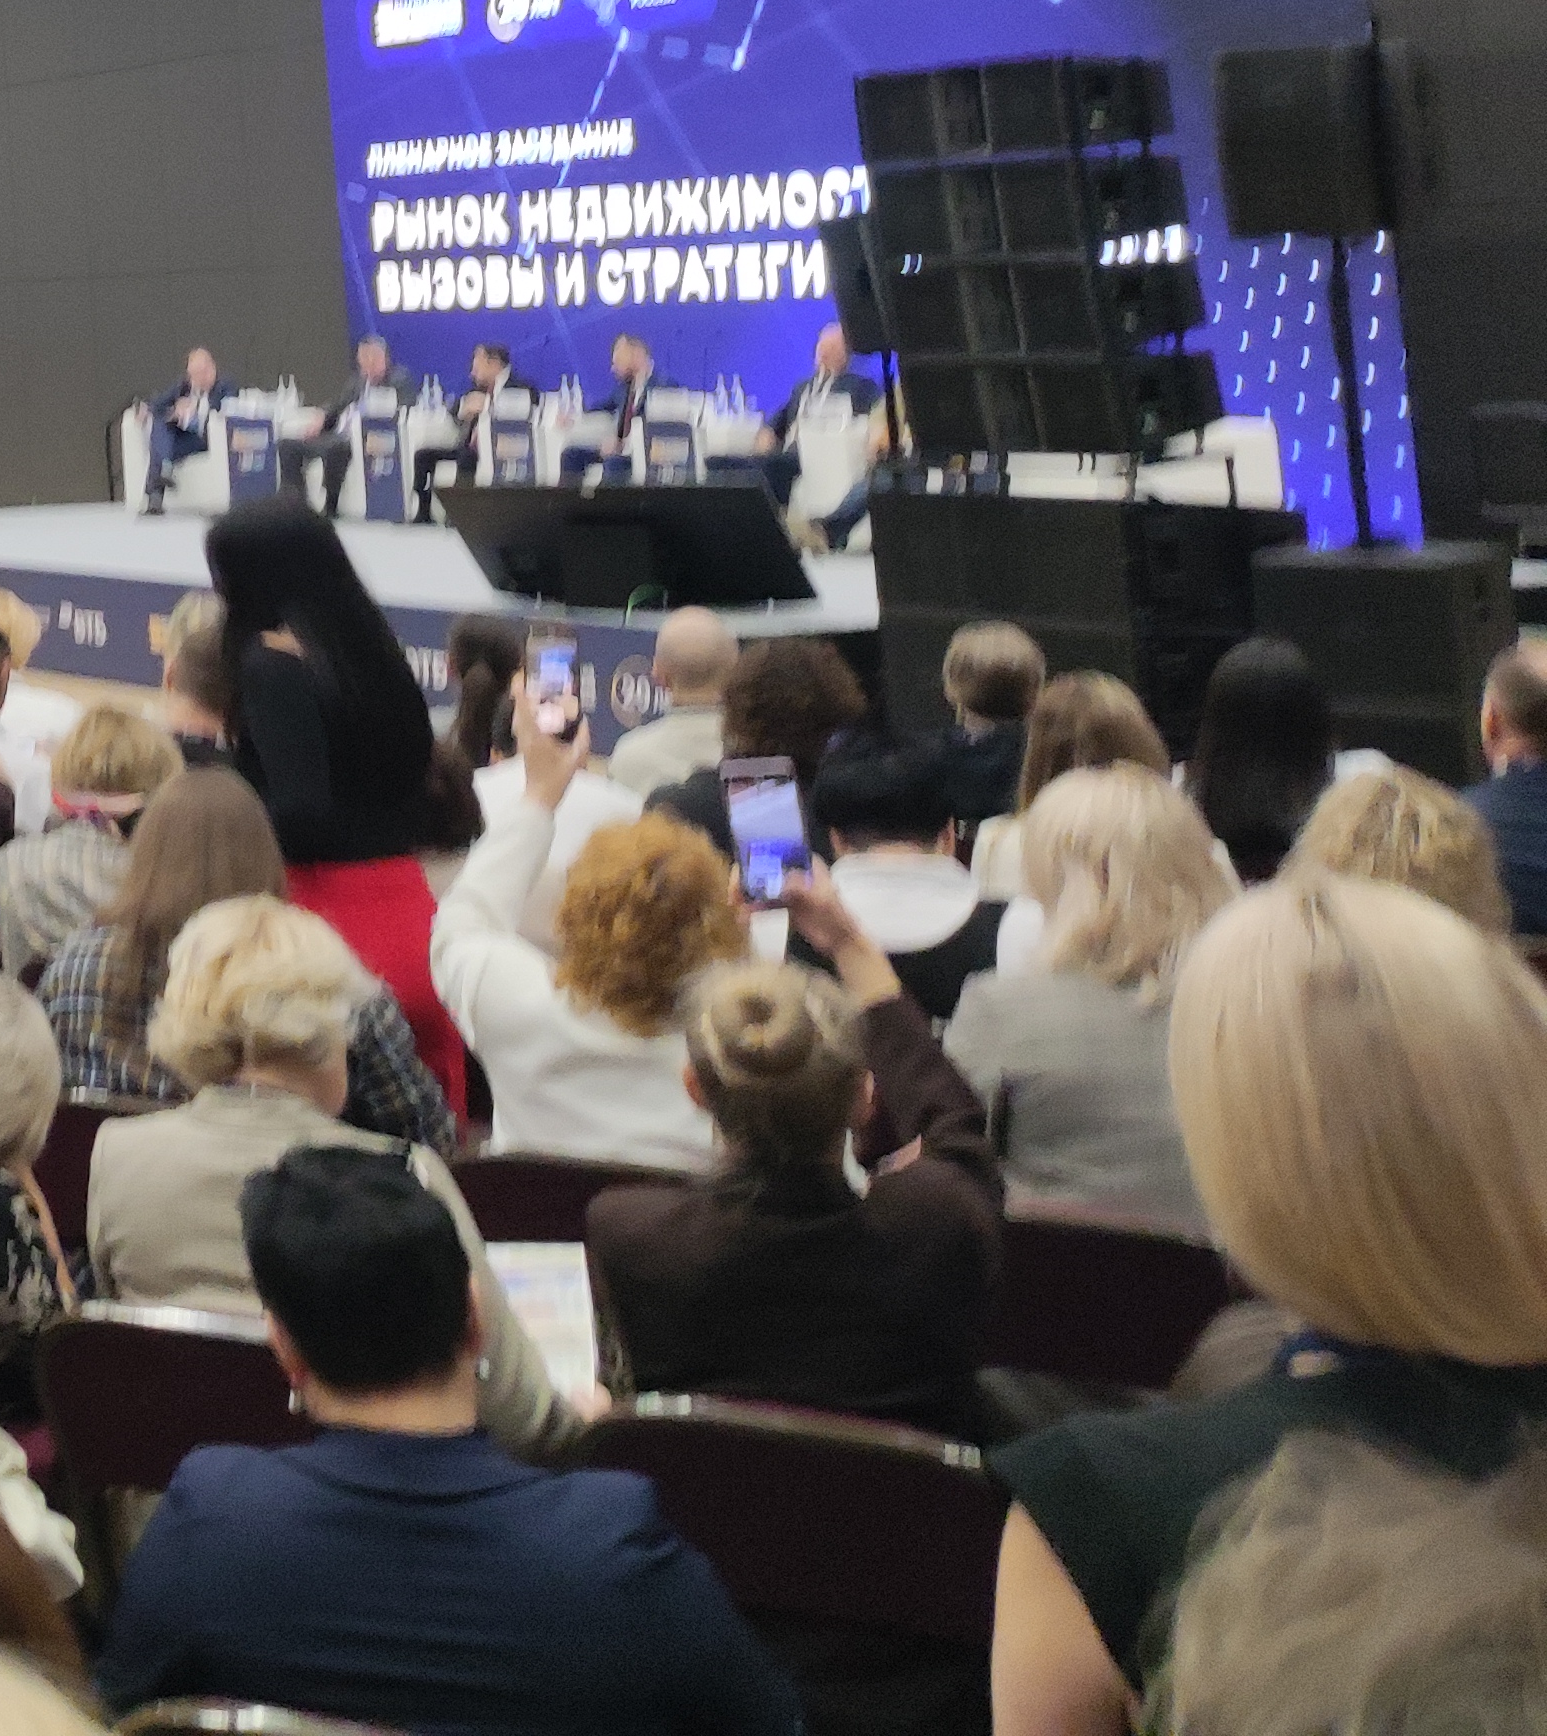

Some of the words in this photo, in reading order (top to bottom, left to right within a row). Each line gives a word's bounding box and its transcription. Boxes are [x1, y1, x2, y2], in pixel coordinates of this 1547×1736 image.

[367, 131, 492, 179] ПЛЕНАРНОЕ
[495, 117, 633, 167] ЗАСЕДАНИЕ
[371, 190, 511, 253] РЫНОК
[376, 252, 545, 313] ВЫЗОВЫ
[555, 250, 586, 307] И
